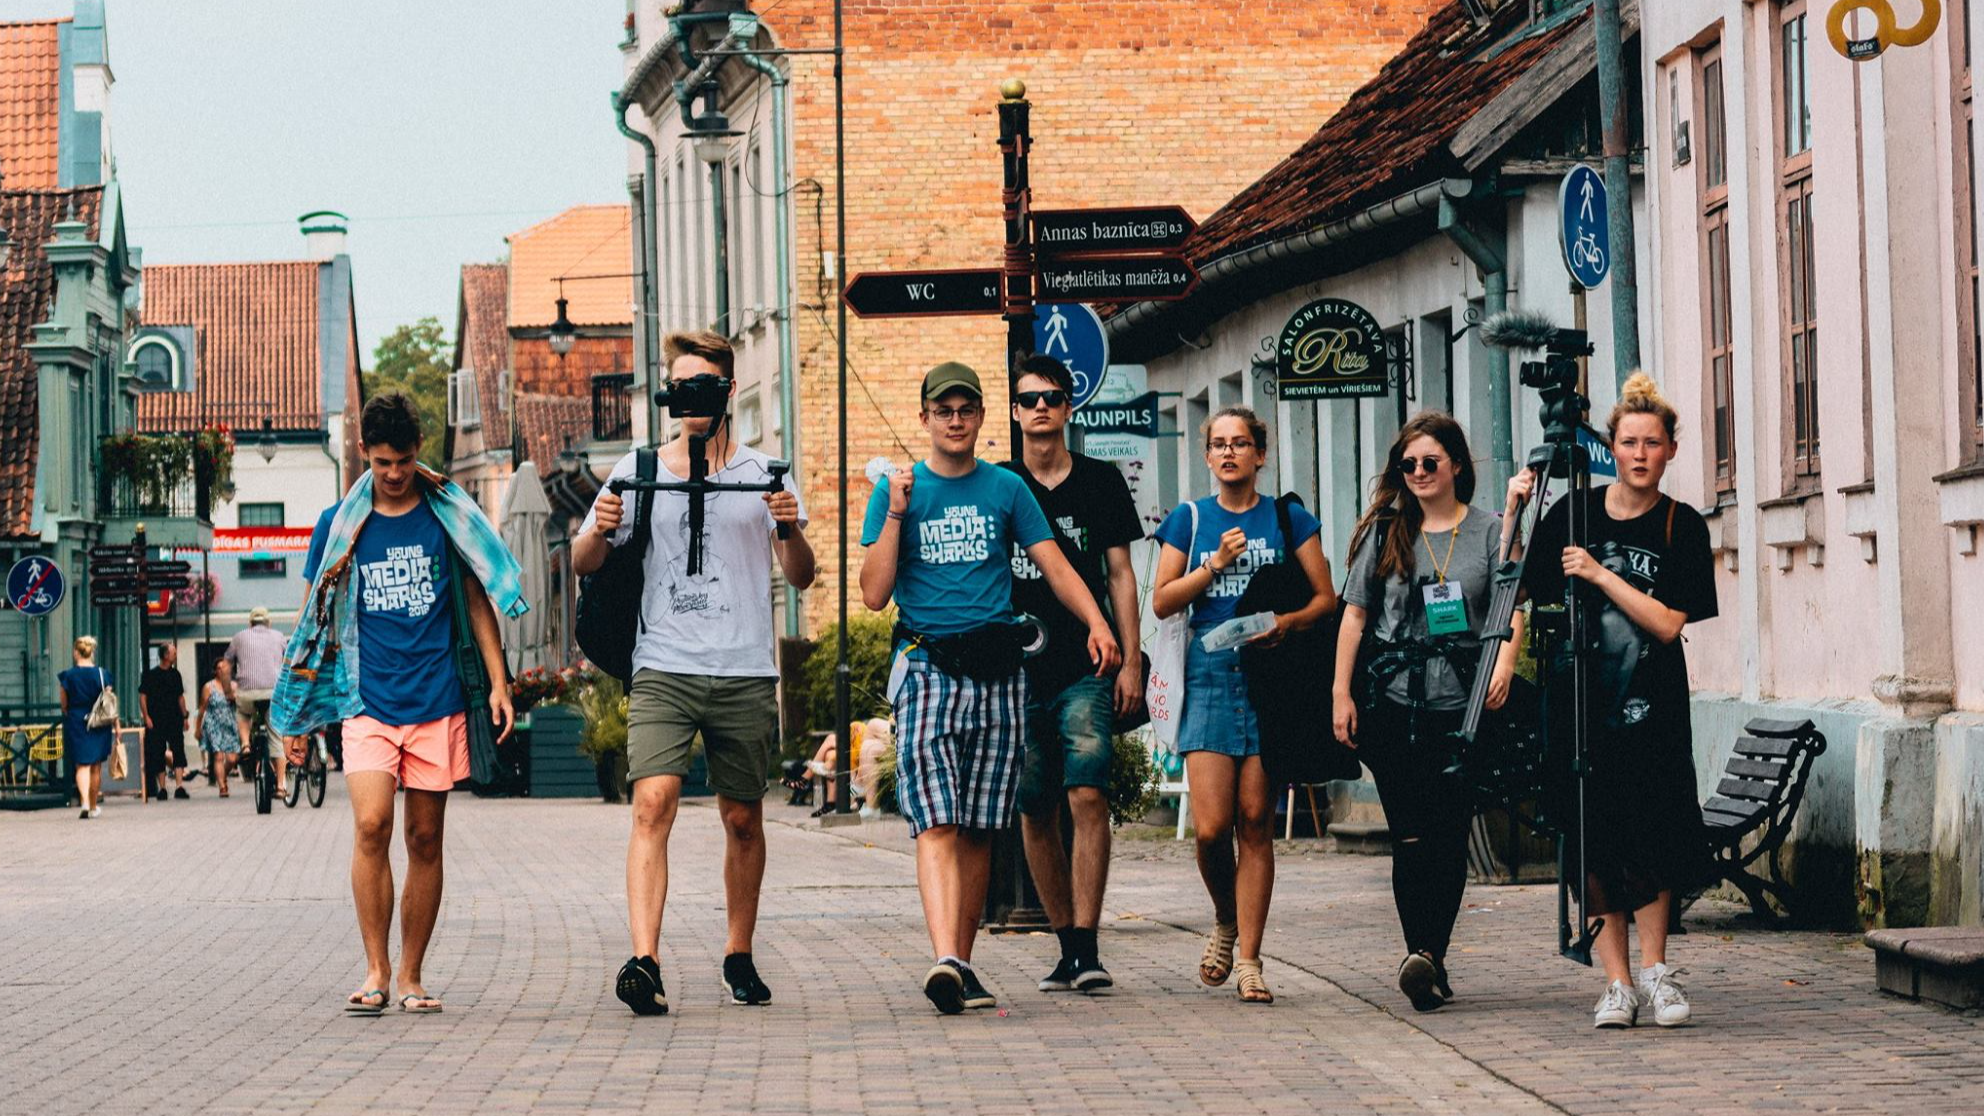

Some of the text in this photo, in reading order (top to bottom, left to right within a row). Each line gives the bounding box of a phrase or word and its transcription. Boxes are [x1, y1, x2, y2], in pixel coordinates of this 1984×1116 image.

[1041, 221, 1183, 242] Annas baznīca 0,3
[1125, 268, 1171, 286] manēža
[1173, 273, 1187, 284] 0,4
[906, 282, 997, 301] WC 0,1
[1284, 383, 1381, 396] SIEVIETĒM un VĪRIEŠIEM
[1069, 408, 1152, 428] AUNPILS
[1107, 445, 1139, 457] VEIKALS
[1587, 441, 1613, 466] WC
[944, 504, 978, 519] YOUNG
[919, 516, 987, 544] MEDIA
[386, 545, 423, 560] YOUNG
[920, 539, 990, 565] SHARKS
[360, 557, 432, 588] MEDIA
[362, 581, 437, 612] SHARKS
